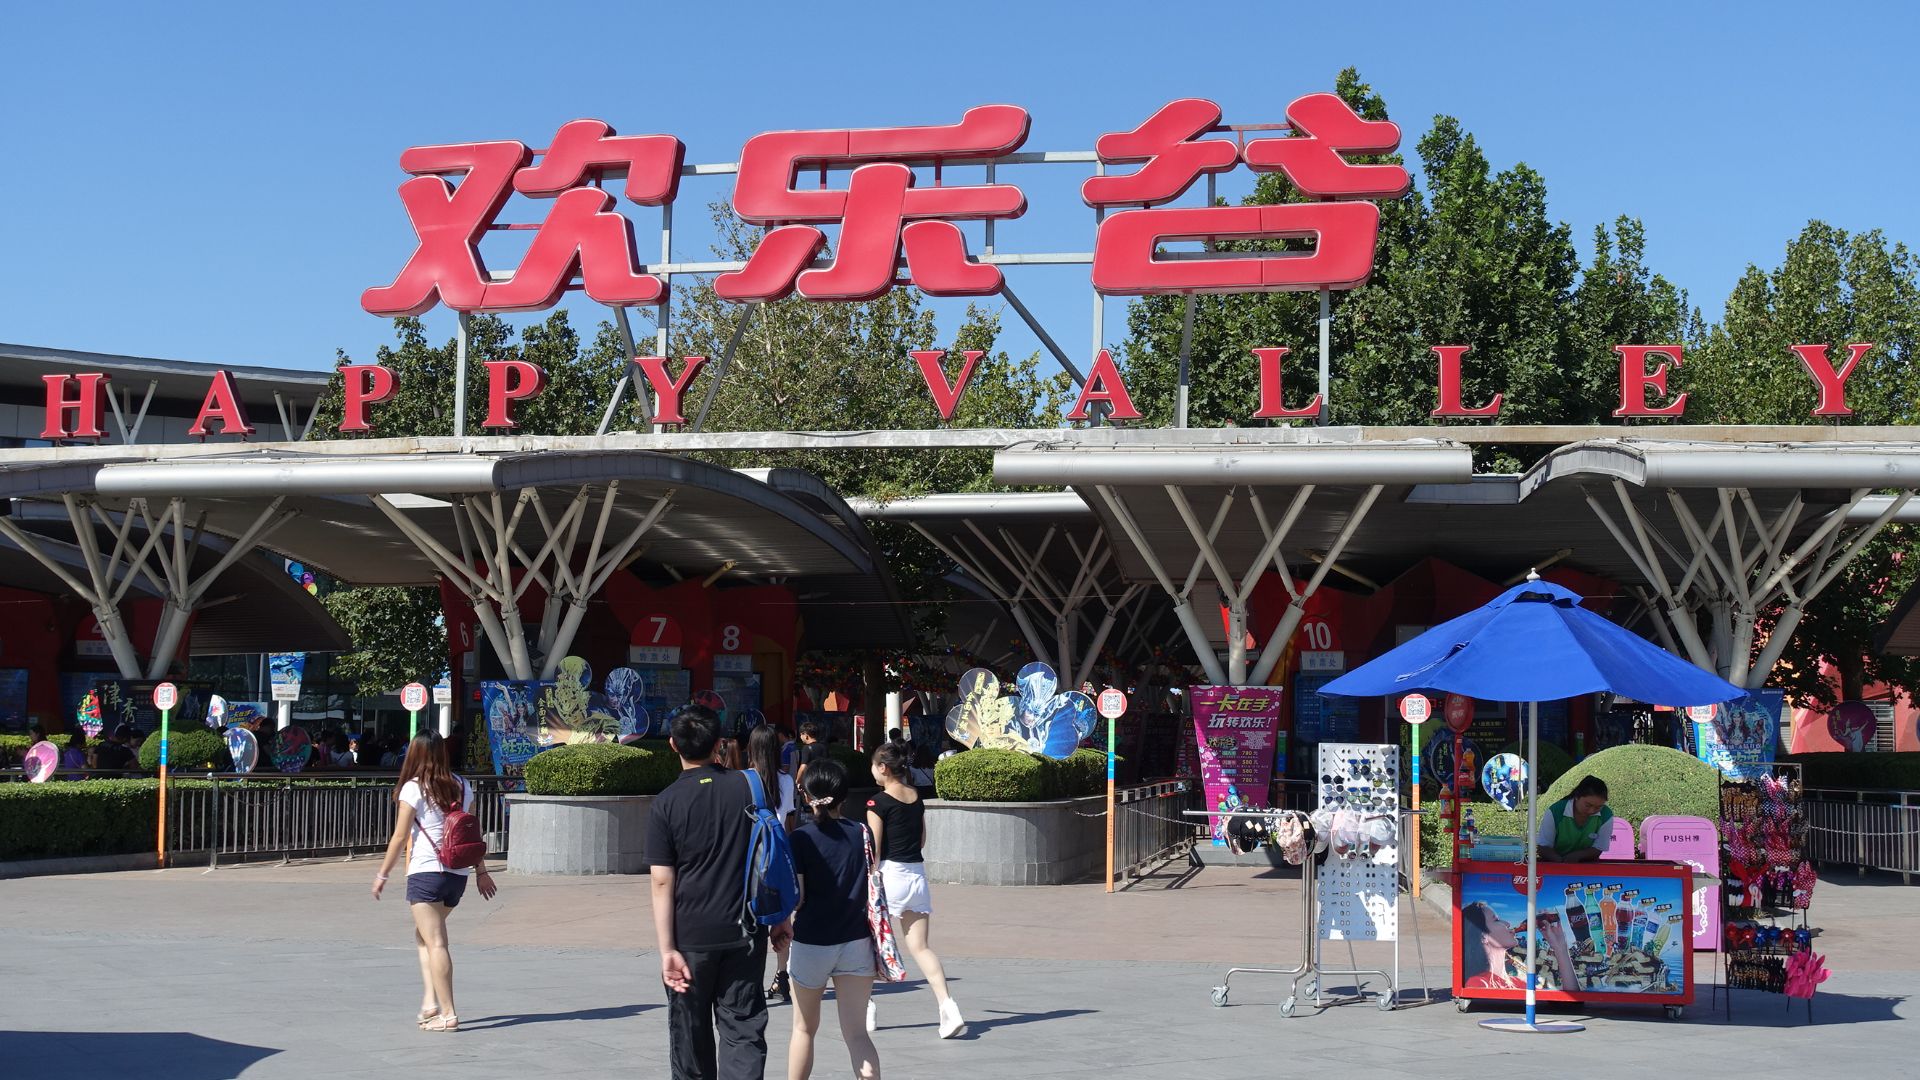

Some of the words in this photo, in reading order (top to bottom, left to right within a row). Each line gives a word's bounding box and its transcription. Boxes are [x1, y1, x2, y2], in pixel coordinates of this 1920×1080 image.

[360, 92, 1411, 317] 欢乐谷
[41, 355, 710, 439] HAPPY
[909, 343, 1874, 421] VALLEY
[460, 622, 469, 647] 6
[651, 617, 667, 643] 7
[723, 625, 740, 650] 8
[1304, 622, 1332, 649] 10
[1200, 694, 1271, 712] 一卡在手
